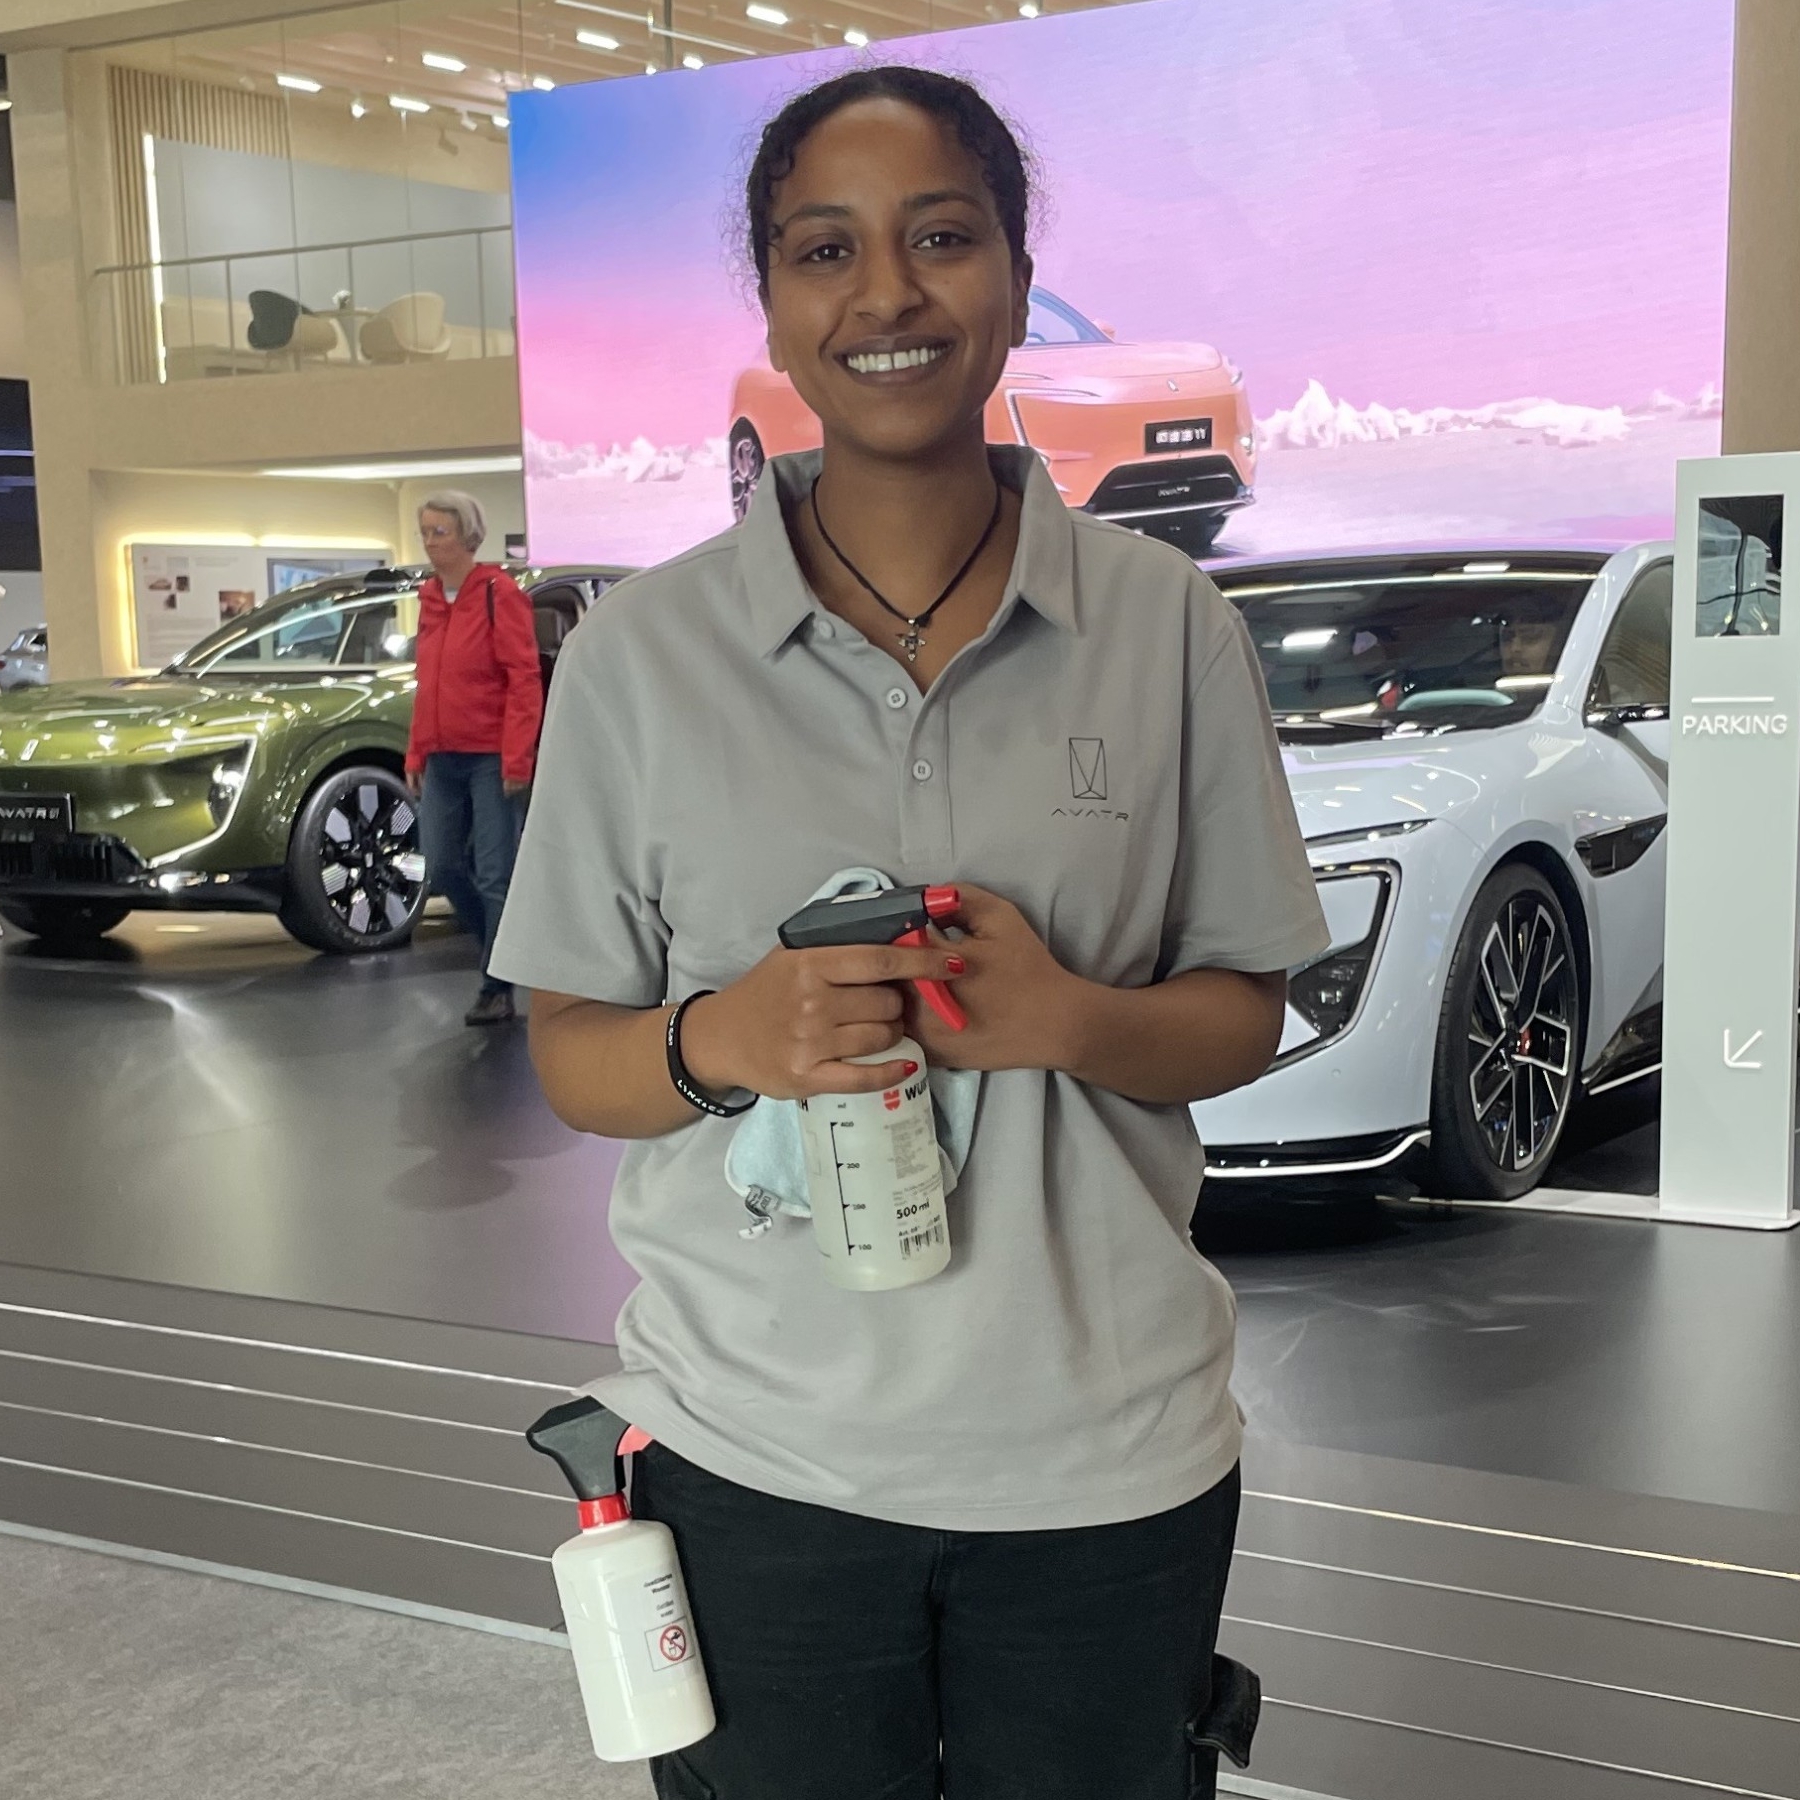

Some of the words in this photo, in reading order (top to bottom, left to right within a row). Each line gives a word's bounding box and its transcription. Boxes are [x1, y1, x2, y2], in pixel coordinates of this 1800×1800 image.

[1682, 714, 1788, 735] PARKING
[1051, 808, 1129, 821] AVATR
[896, 1204, 918, 1219] 500
[919, 1197, 930, 1211] ml
